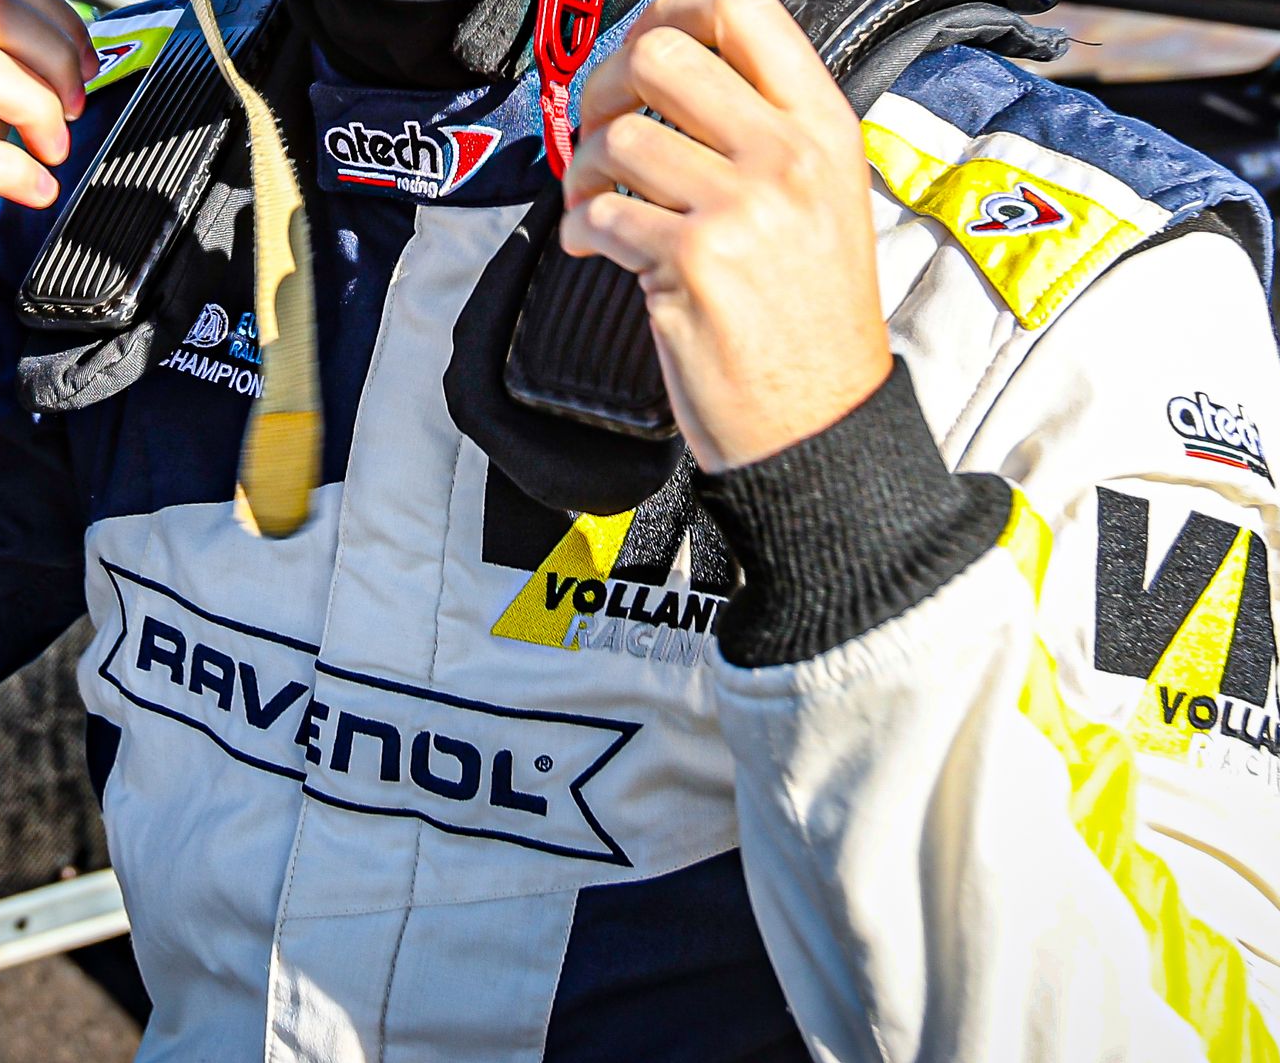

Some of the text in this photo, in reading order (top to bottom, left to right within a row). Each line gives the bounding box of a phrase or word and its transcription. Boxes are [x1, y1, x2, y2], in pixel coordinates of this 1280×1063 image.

[325, 120, 443, 180] atech
[159, 348, 265, 399] HAMPION
[228, 340, 265, 365] RALL
[545, 571, 722, 636] VOLLAN
[136, 615, 549, 817] RAVENOL
